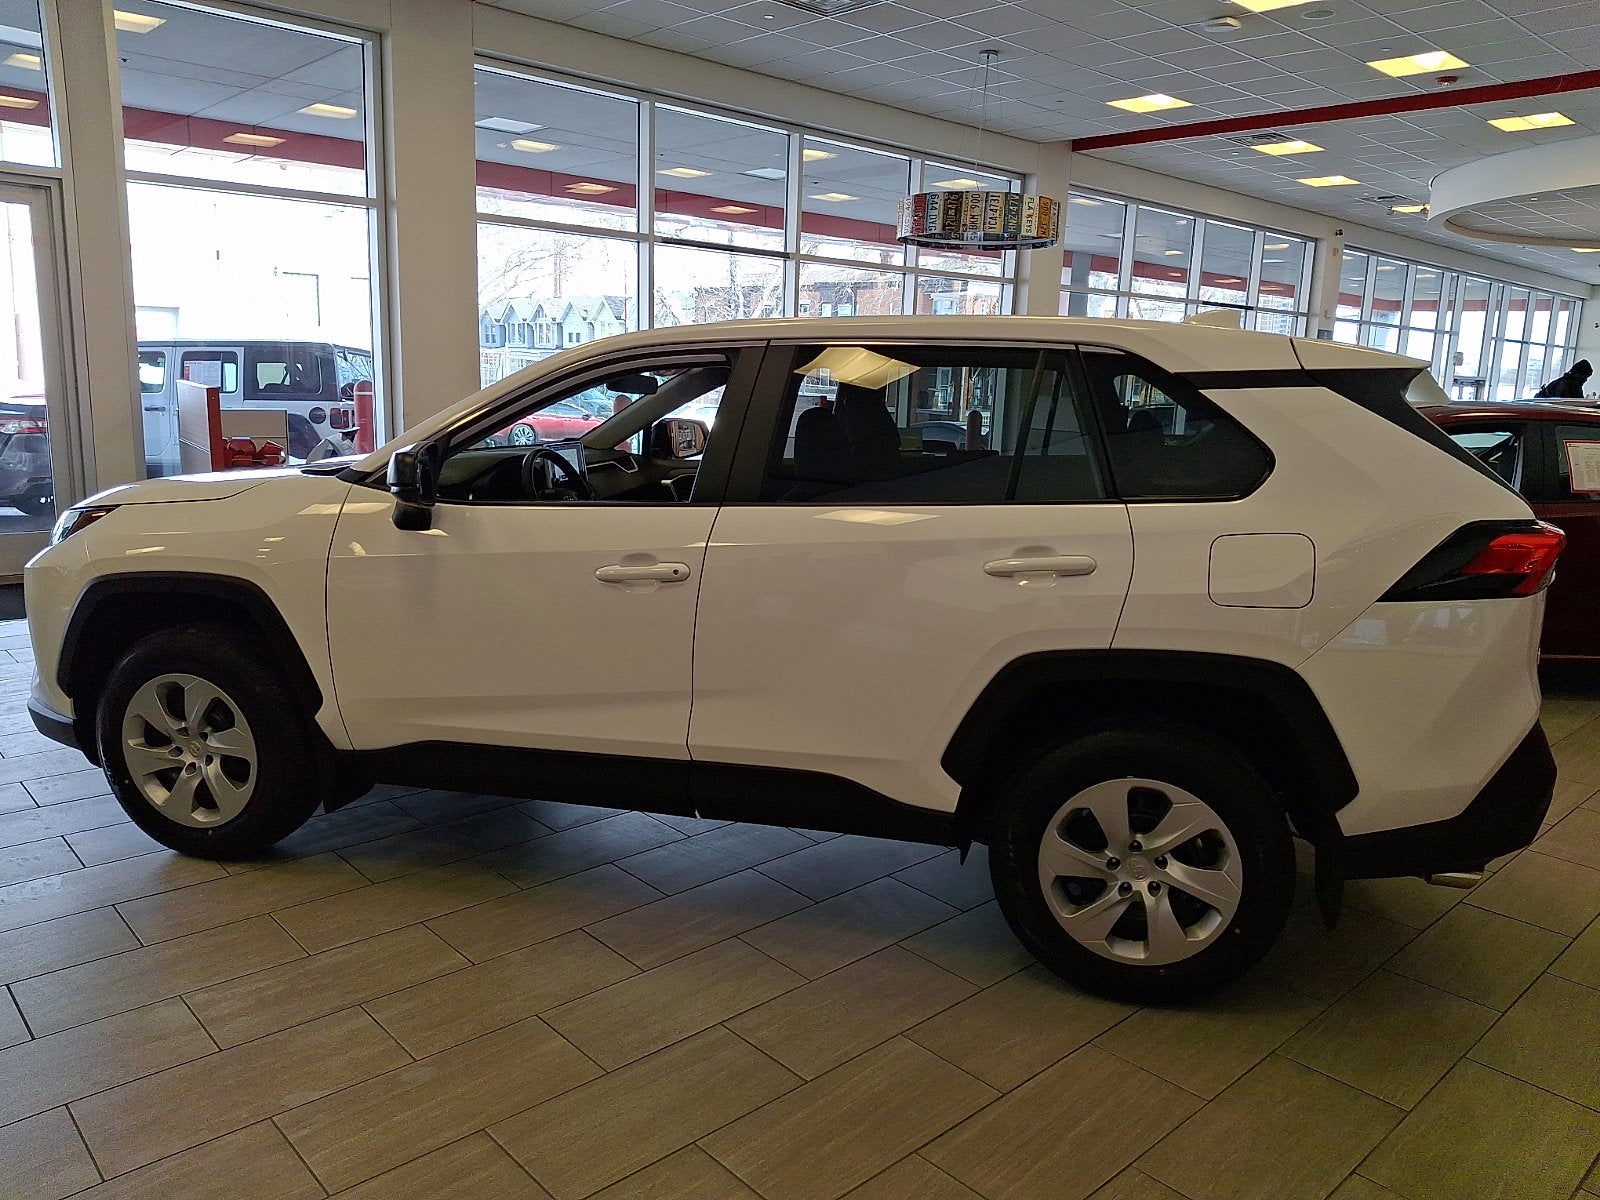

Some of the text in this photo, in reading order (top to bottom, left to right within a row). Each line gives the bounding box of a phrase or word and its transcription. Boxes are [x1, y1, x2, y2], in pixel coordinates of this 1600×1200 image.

[928, 194, 940, 232] 644 DYG
[970, 193, 981, 210] 900
[1025, 196, 1035, 234] FLA KEYS
[969, 214, 979, 230] BKN
